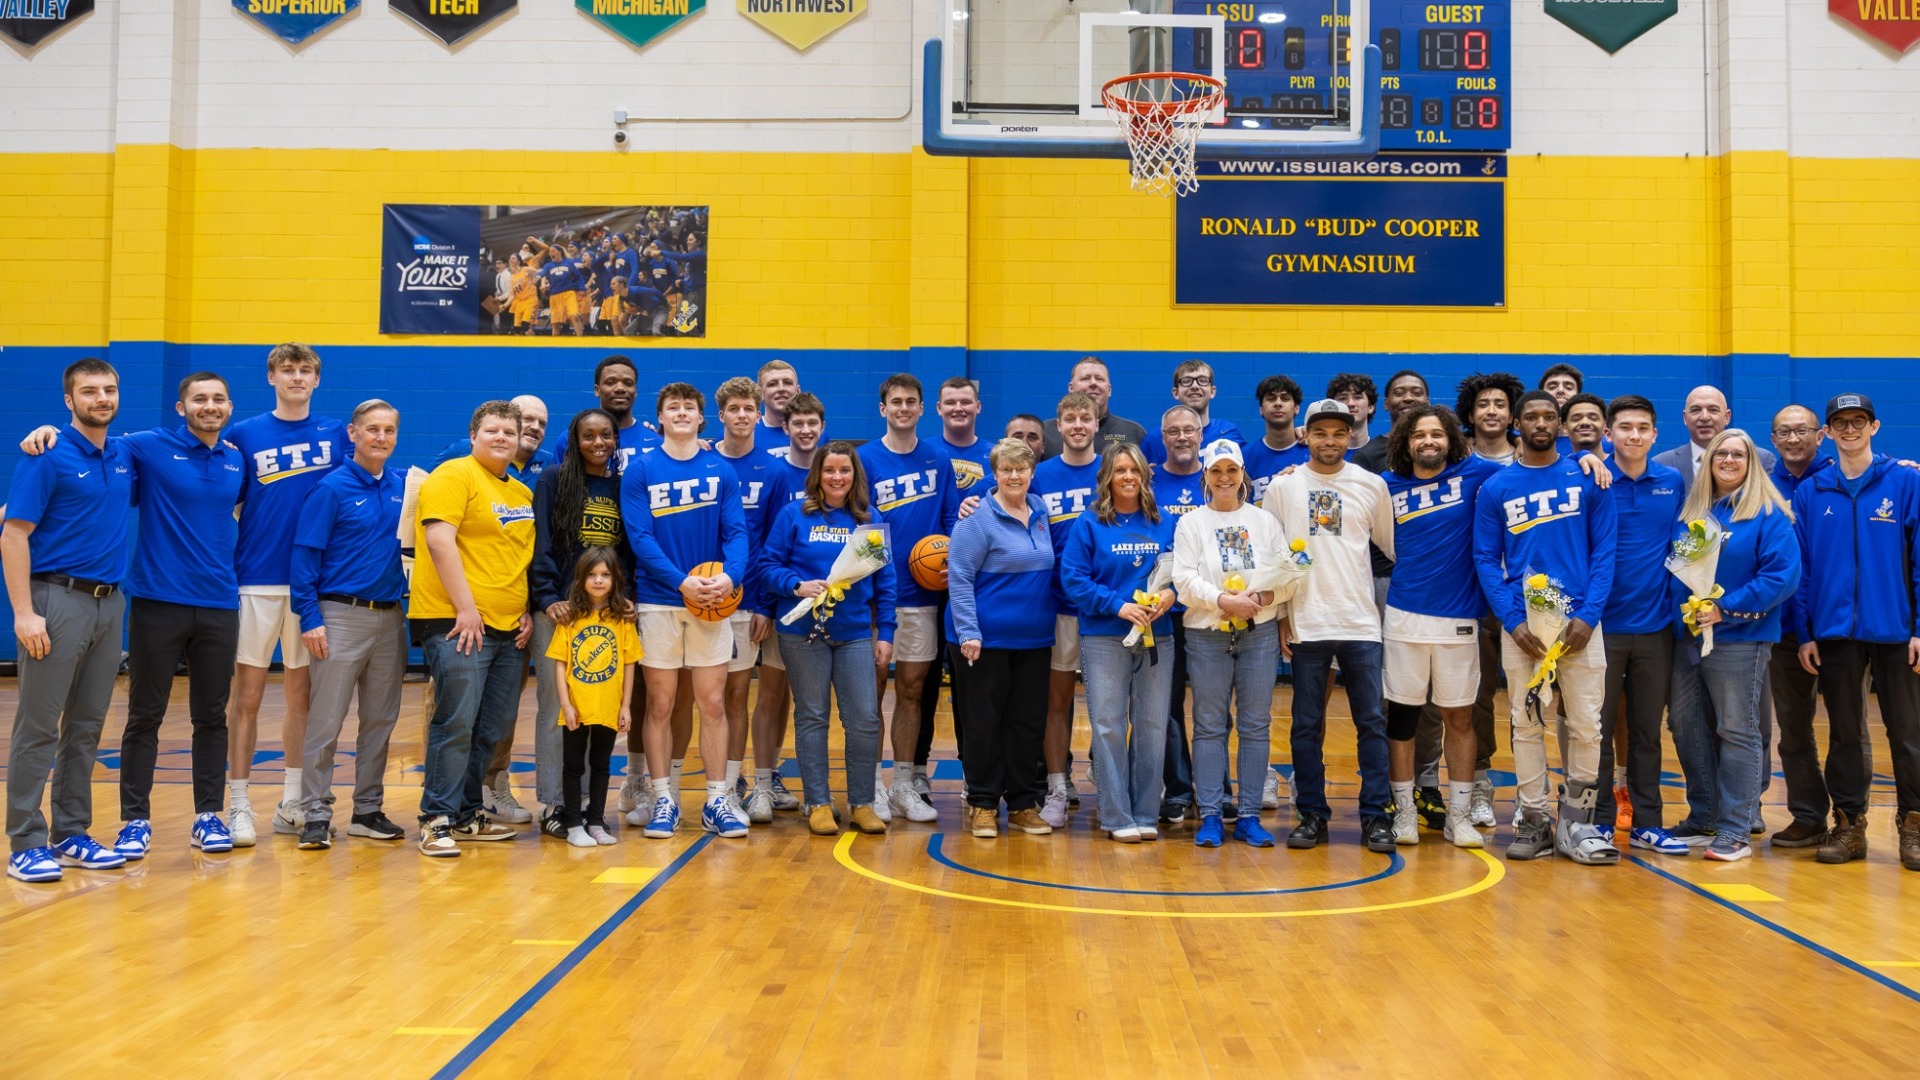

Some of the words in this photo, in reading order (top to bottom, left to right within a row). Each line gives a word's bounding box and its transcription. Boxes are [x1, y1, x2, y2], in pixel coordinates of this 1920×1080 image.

[429, 0, 479, 15] TECH
[593, 0, 689, 16] MICHIGAN
[1425, 5, 1484, 23] GUEST
[1858, 0, 1920, 20] VALLE
[1290, 76, 1315, 89] PLYR
[1457, 77, 1497, 90] FOULS
[1415, 130, 1452, 143] T.O.L.
[1200, 217, 1297, 236] RONALD
[1384, 219, 1480, 238] COOPER
[423, 255, 457, 265] MAKE
[457, 255, 470, 265] IT
[1266, 254, 1416, 273] GYMNASIUM
[253, 441, 332, 477] ETJ
[647, 476, 720, 509] ETJ
[874, 469, 938, 505] ETJ
[1042, 487, 1092, 516] ET
[1391, 476, 1463, 518] ETJ
[1503, 486, 1582, 527] ETJ
[581, 515, 620, 533] LSSU
[811, 525, 828, 533] LAKE
[829, 527, 849, 535] STATE
[809, 532, 852, 543] BASKET
[1111, 543, 1133, 552] LAKE
[1134, 542, 1160, 551] STATE
[581, 640, 609, 668] Lakers
[576, 669, 612, 682] STATE
